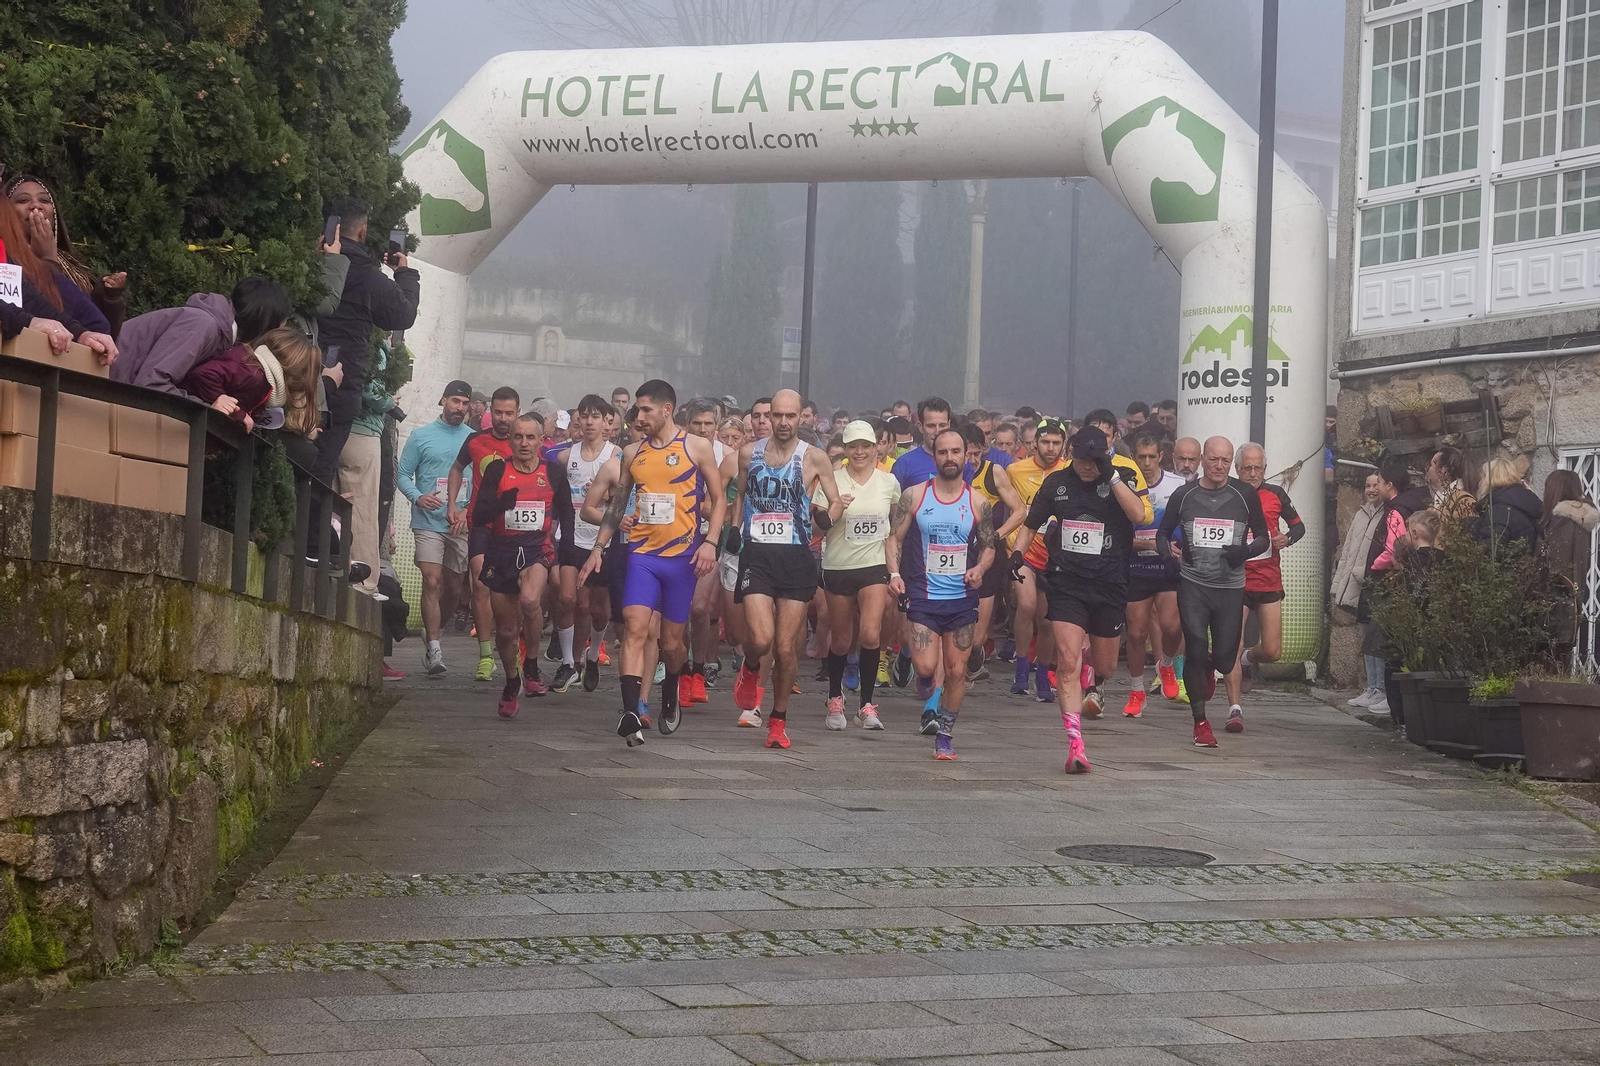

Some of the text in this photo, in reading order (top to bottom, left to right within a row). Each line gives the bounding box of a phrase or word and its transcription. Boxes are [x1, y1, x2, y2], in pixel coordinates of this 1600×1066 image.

[520, 73, 678, 119] HOTEL
[709, 69, 770, 115] LA
[523, 123, 820, 155] www.hotelrectoral.com
[1182, 305, 1292, 318] INGENIERÍA&INMOARIA
[1187, 394, 1275, 406] www.rodesps
[650, 502, 656, 516] 1
[752, 497, 797, 513] UNNERS
[514, 510, 537, 523] 153
[761, 522, 784, 535] 103
[853, 522, 878, 535] 655
[1202, 527, 1225, 541] 159
[1072, 531, 1089, 545] 68
[939, 554, 955, 568] 91
